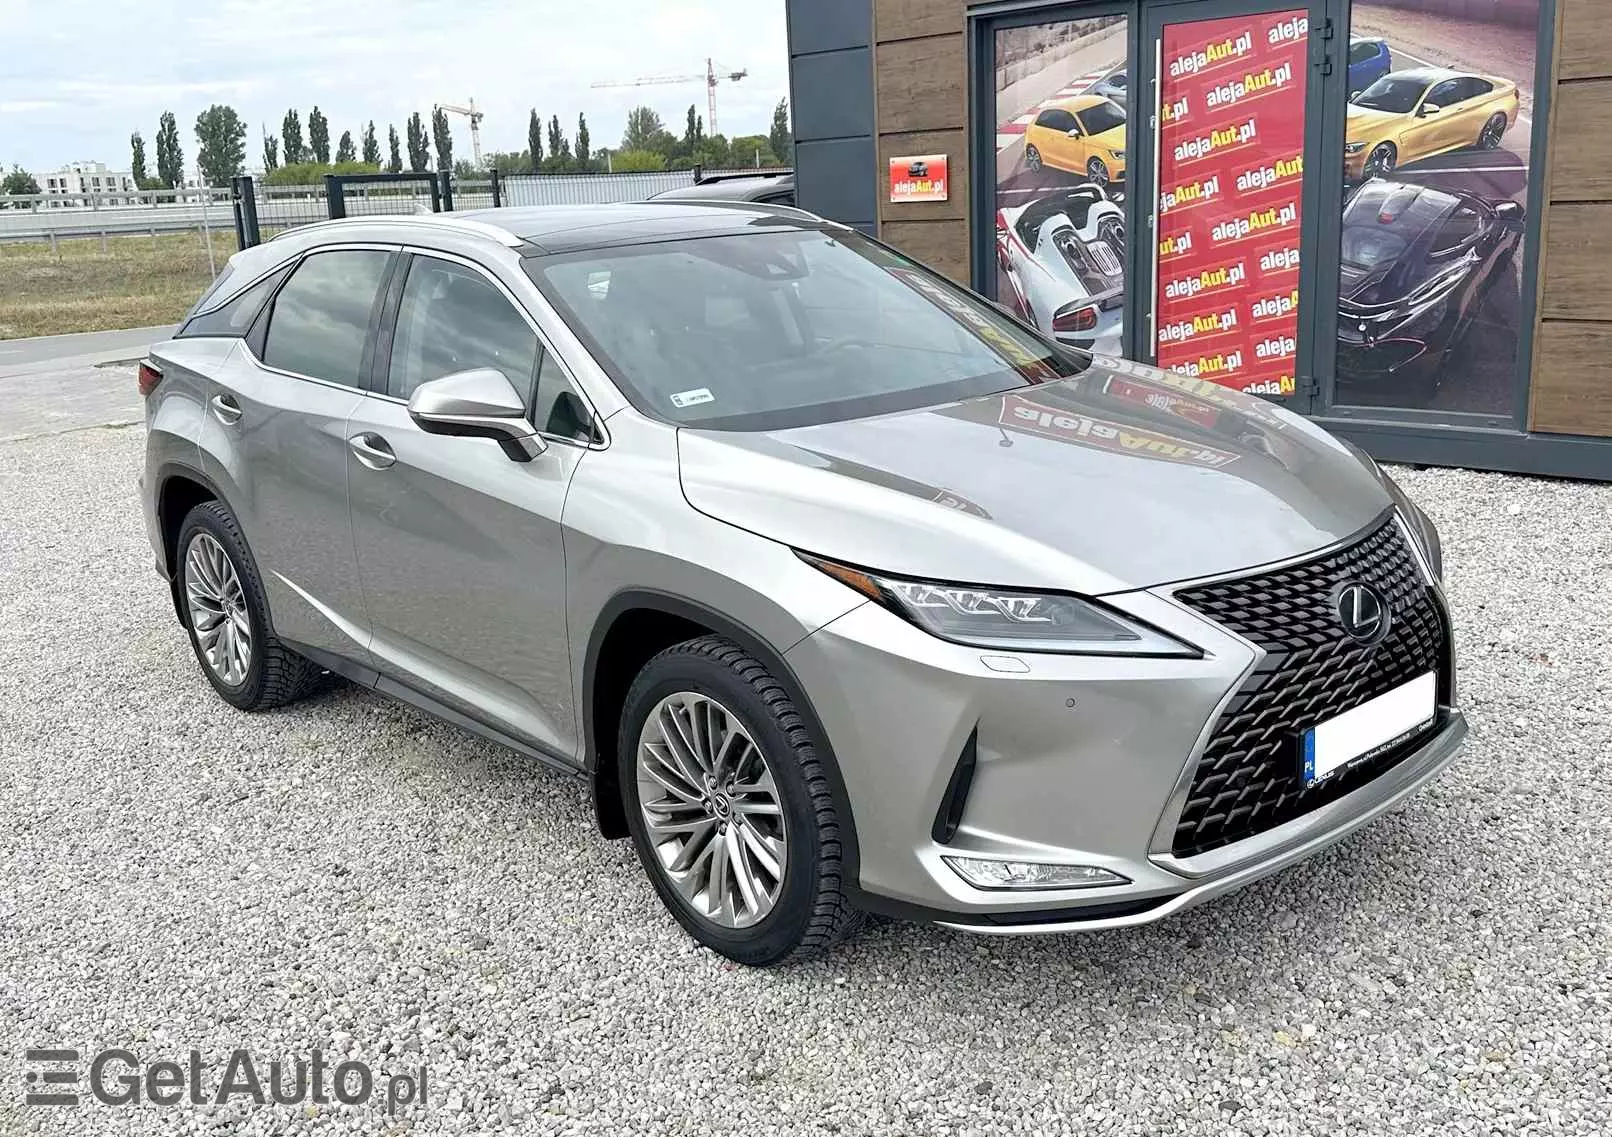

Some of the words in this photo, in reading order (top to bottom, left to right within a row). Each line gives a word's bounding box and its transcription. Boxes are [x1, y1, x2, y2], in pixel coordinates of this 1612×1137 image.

[1169, 31, 1252, 77] alejaAut.pl
[1206, 62, 1292, 106] alejaAut.pl
[1174, 119, 1256, 161] alejaAut.pl
[894, 179, 944, 195] alejaAut.pl
[1212, 202, 1296, 241] alejaAut.pl
[1260, 247, 1300, 271] aleja
[1165, 262, 1245, 298] alejaAut.pl
[1158, 308, 1237, 341] alejaAut.pl
